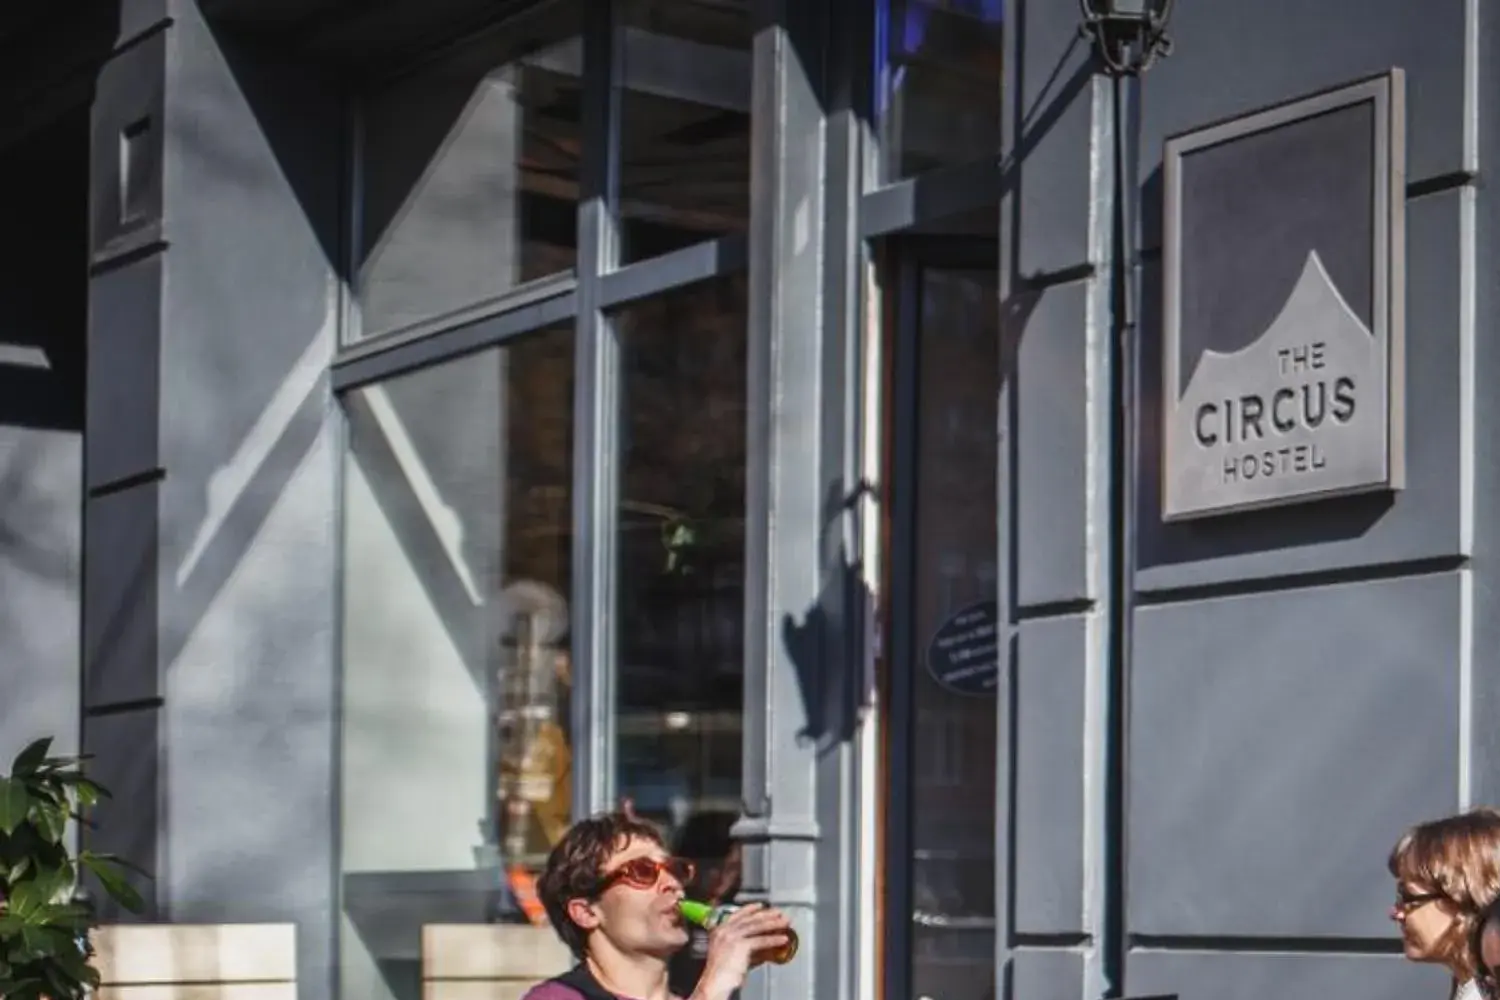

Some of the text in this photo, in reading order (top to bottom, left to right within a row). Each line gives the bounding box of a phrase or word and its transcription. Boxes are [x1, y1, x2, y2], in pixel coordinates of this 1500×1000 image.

[1278, 341, 1327, 374] THE
[1195, 376, 1357, 447] CIRCUS
[1223, 445, 1327, 484] HOSTEL
